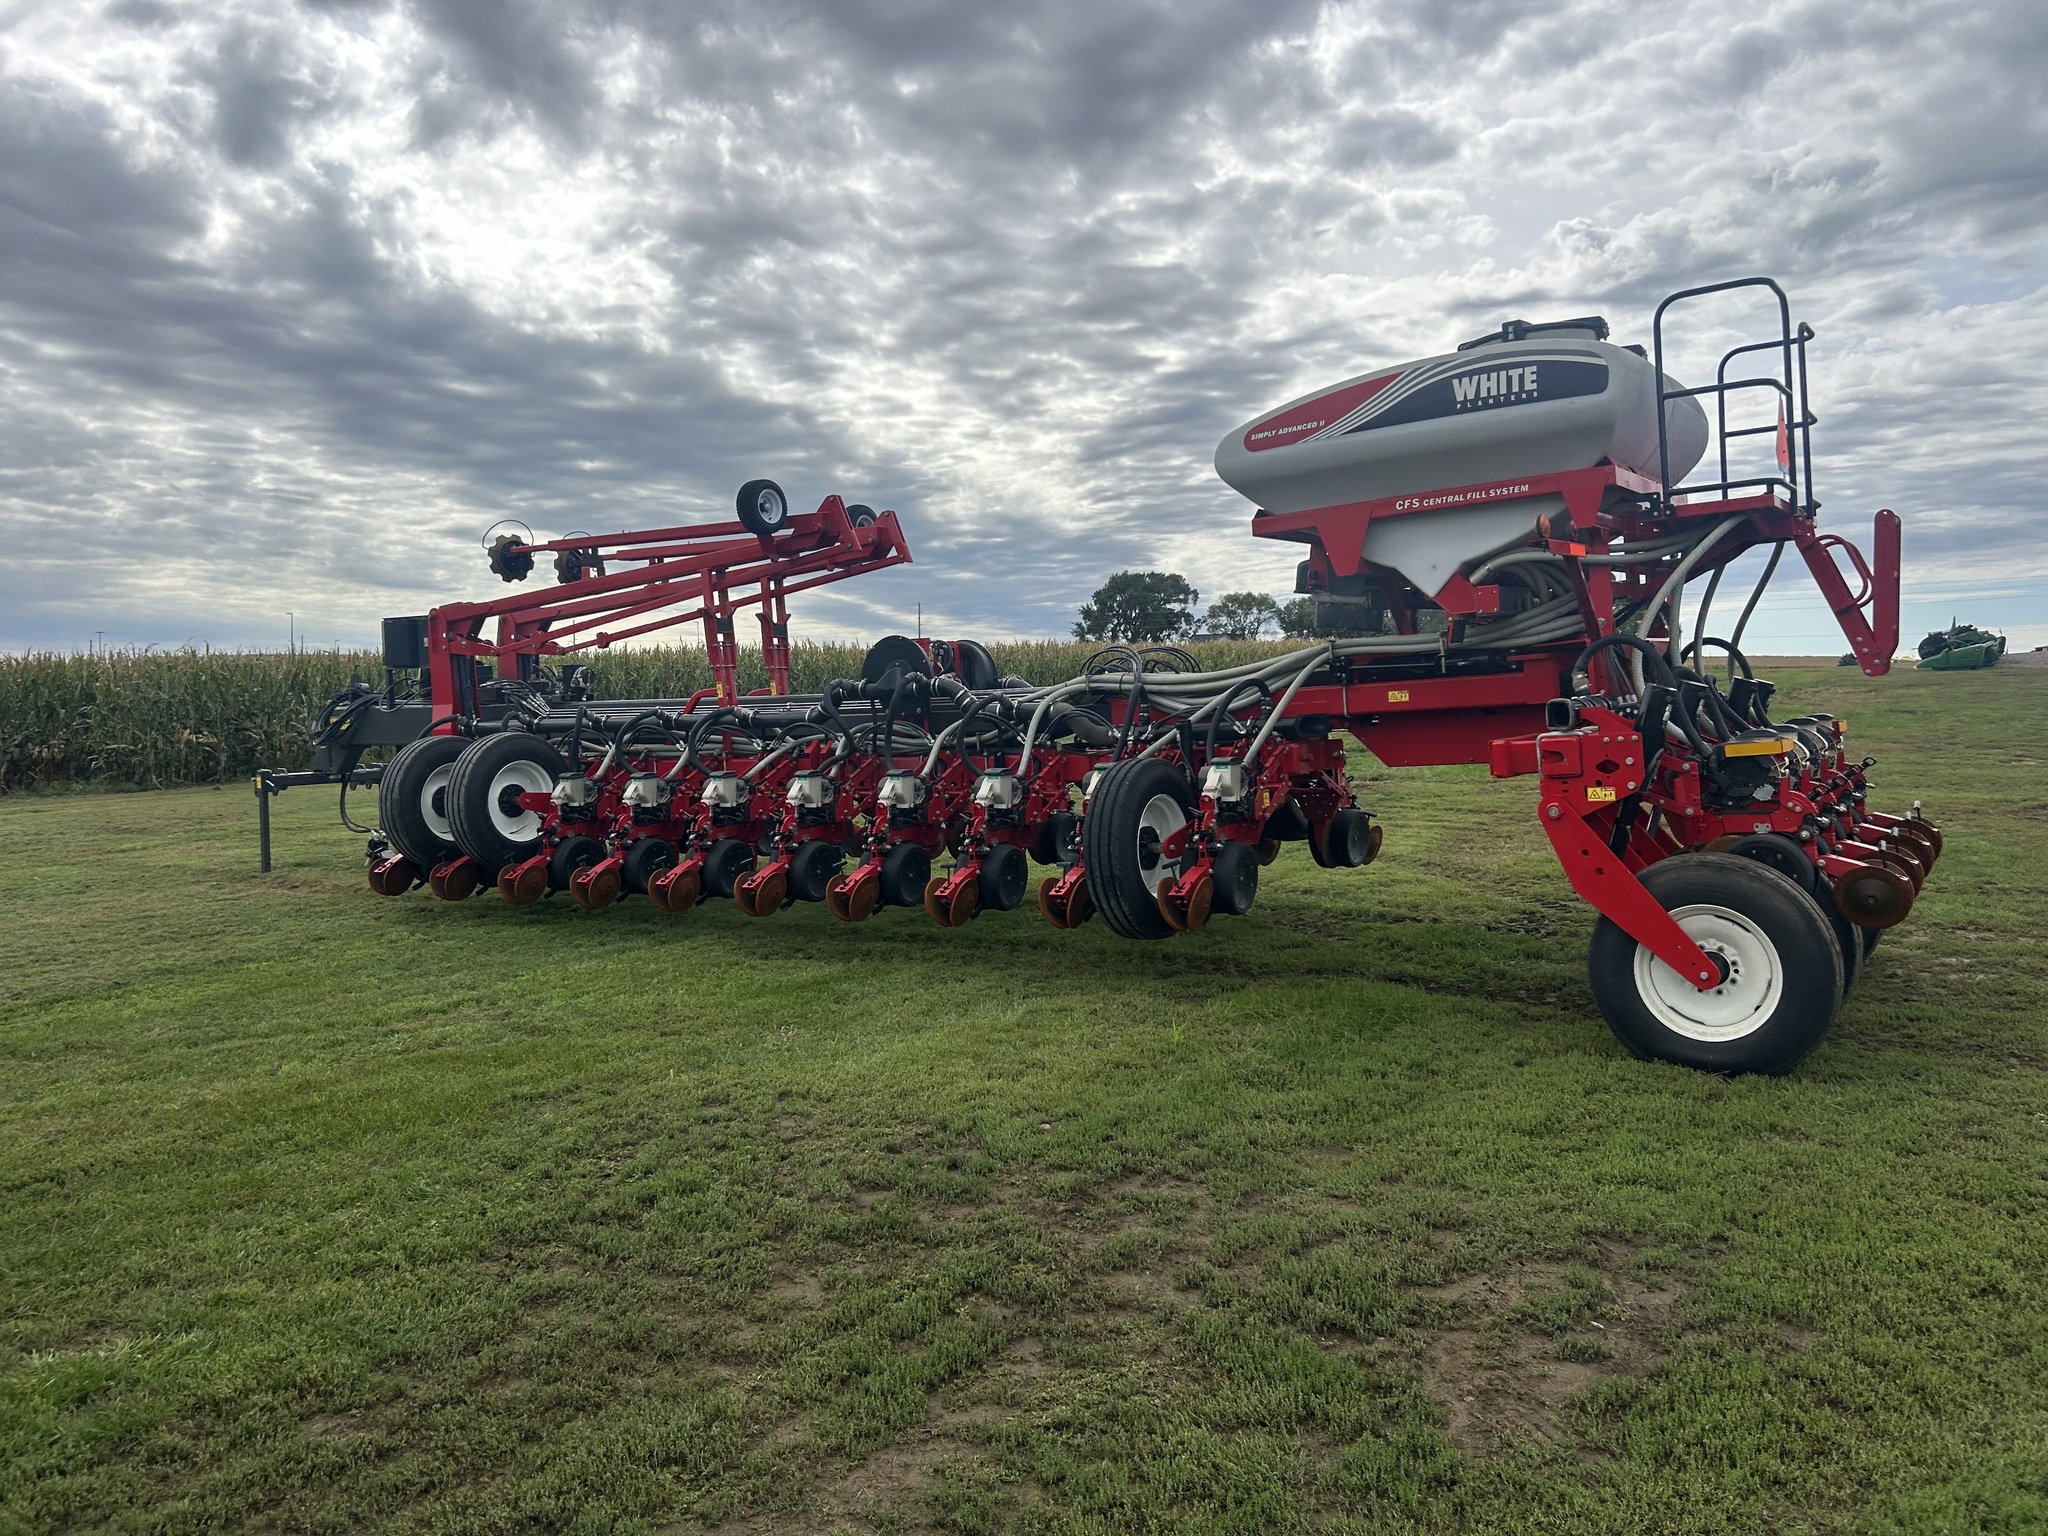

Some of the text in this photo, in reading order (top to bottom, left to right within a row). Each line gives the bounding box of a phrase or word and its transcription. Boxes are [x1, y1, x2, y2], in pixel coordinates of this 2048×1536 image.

[1452, 365, 1537, 401] WHITE
[1456, 391, 1538, 409] PLANTERS
[1251, 430, 1276, 441] SIMPLY
[1278, 421, 1317, 435] ADVANCED
[1395, 484, 1529, 510] CFS CENTRAL FILL SYSTEM
